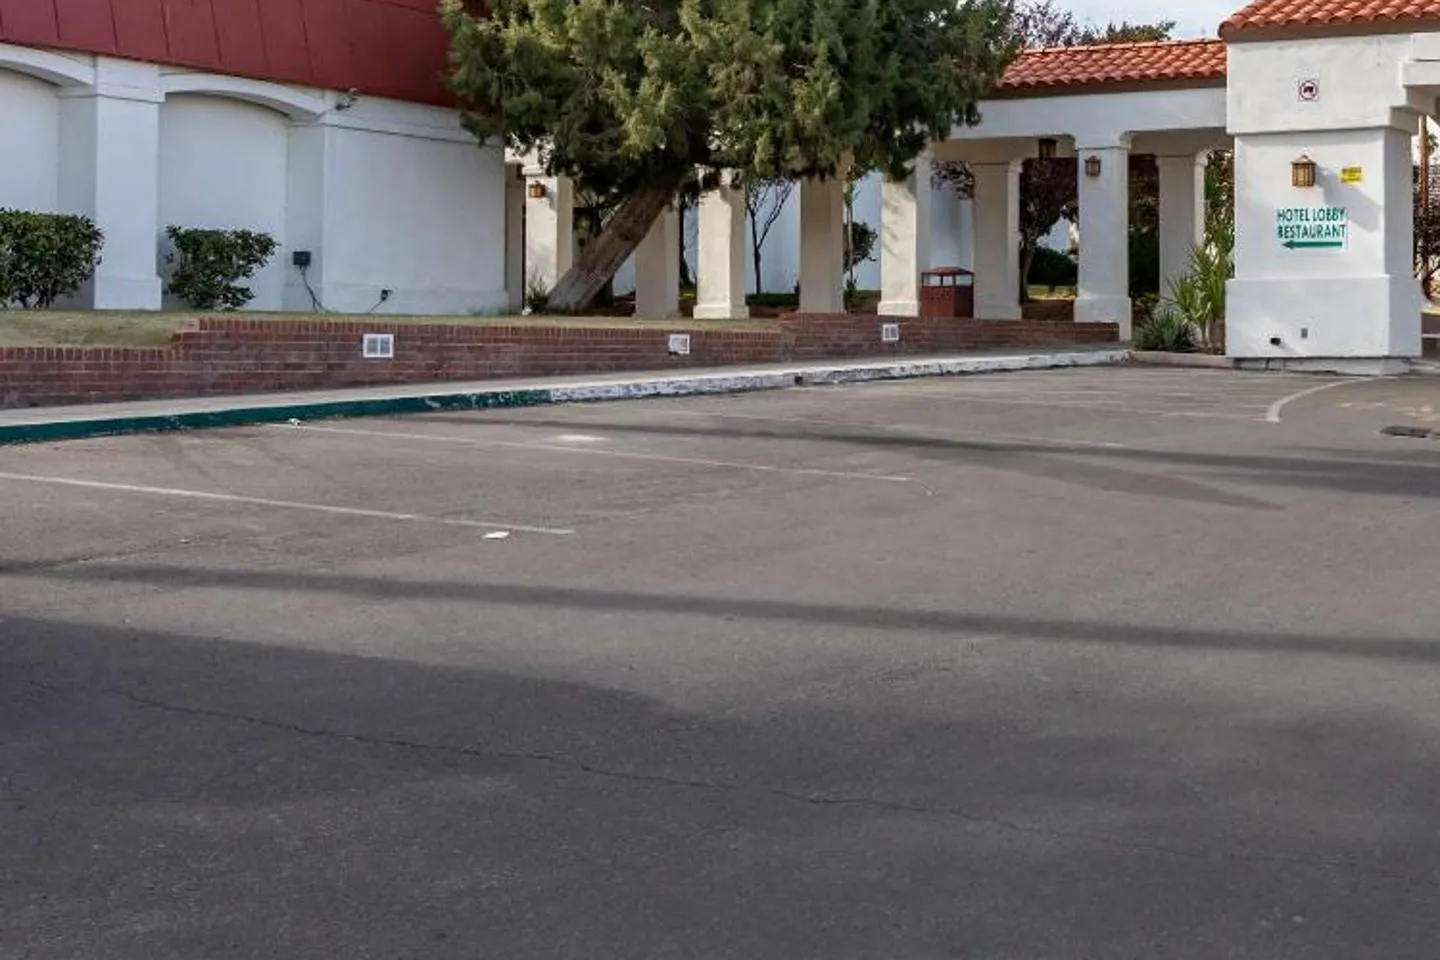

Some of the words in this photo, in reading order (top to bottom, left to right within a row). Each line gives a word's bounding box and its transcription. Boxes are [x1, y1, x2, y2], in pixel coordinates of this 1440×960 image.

[1277, 208, 1310, 222] HOTEL
[1312, 207, 1346, 222] LOBBY
[1277, 224, 1346, 239] RESTAURANT
